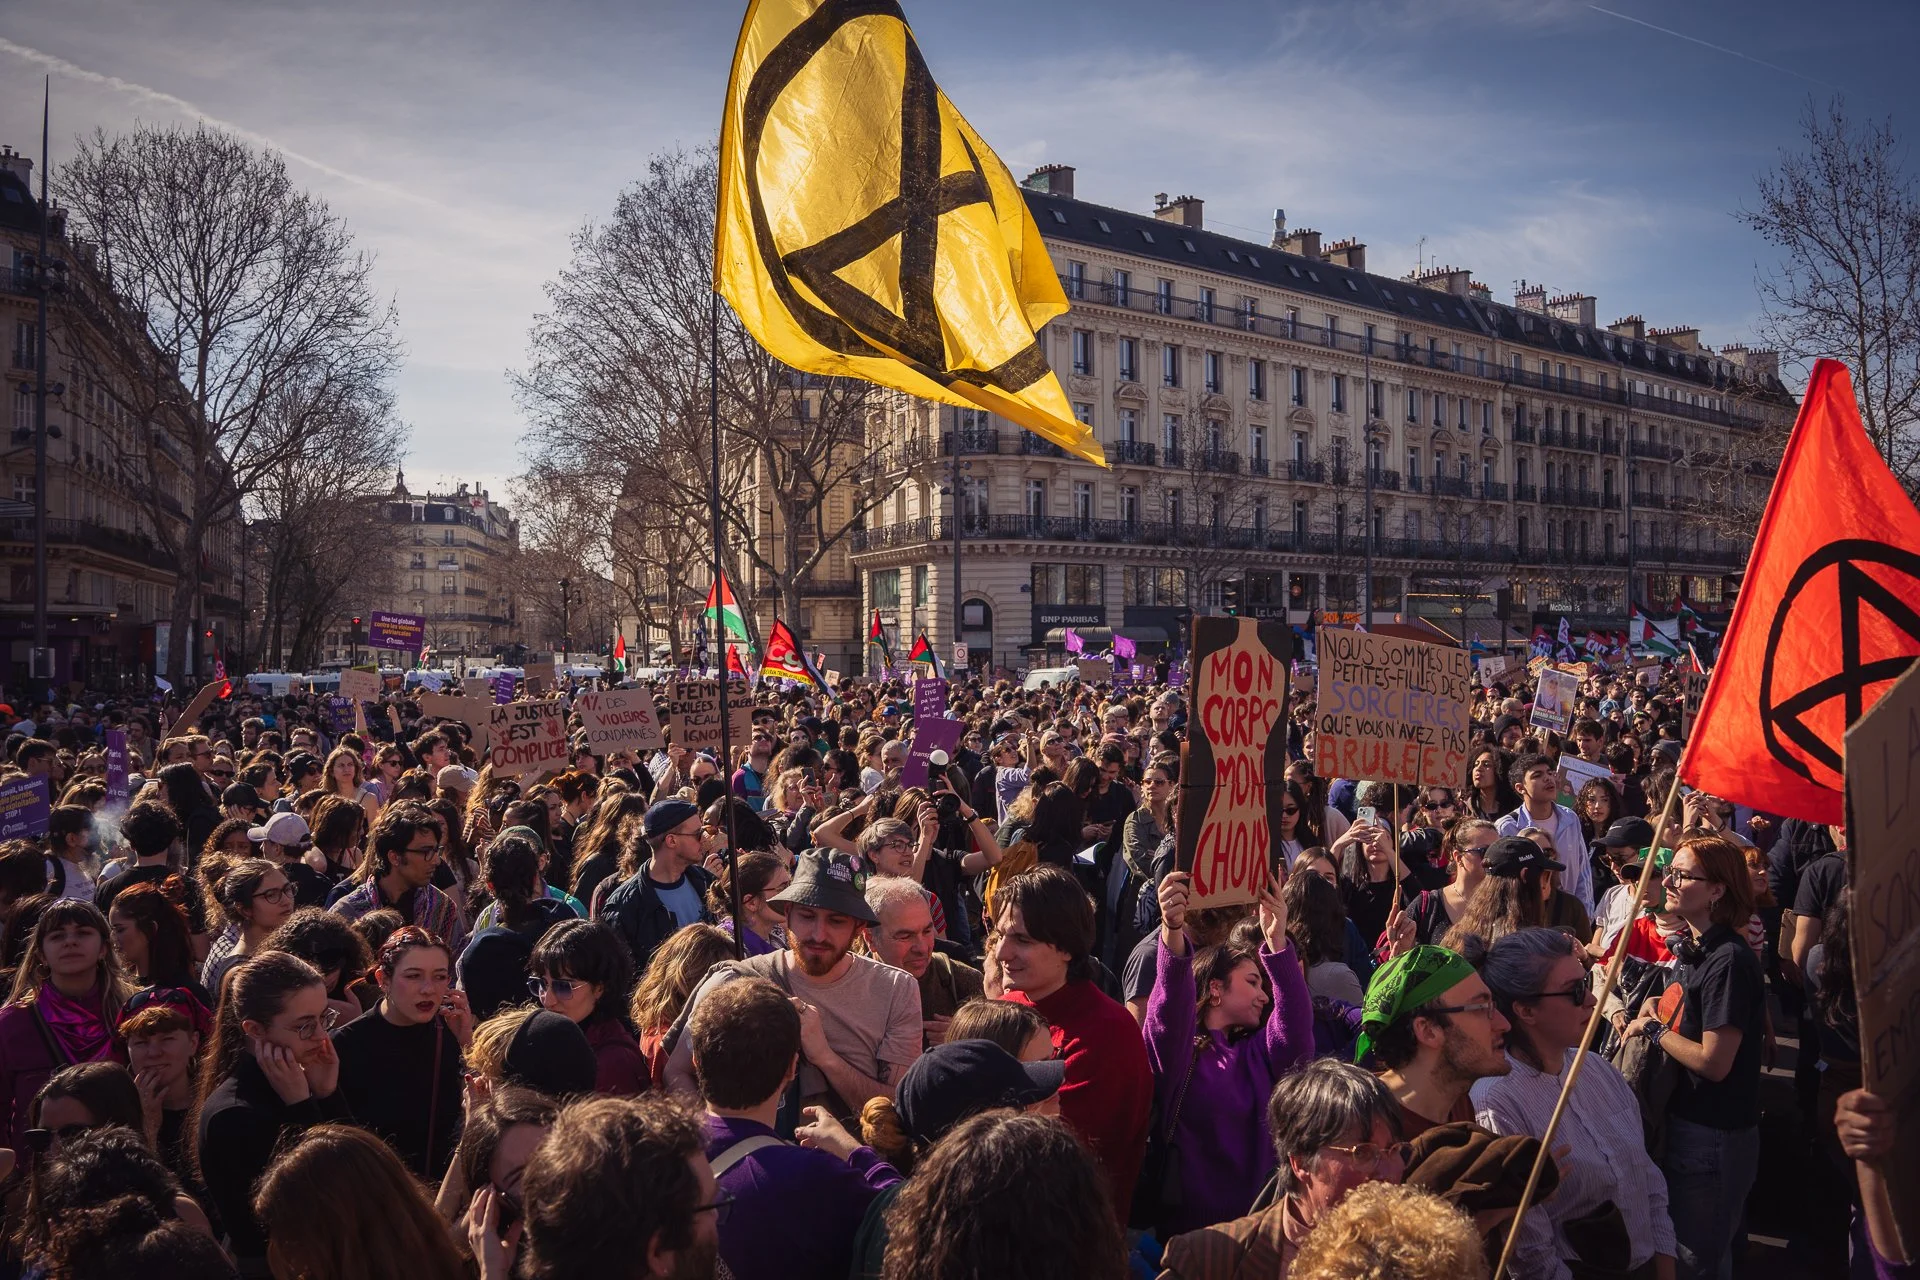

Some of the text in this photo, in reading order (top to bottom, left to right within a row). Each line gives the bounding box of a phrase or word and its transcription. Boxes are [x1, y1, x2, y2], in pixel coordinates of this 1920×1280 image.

[1210, 646, 1274, 696] MON
[1324, 632, 1470, 682] NOUS SOMMES LES
[1441, 676, 1466, 704] DES
[1688, 676, 1708, 693] MO
[491, 702, 561, 724] LA JUSTICE
[582, 694, 627, 711] 1% DES
[1331, 680, 1462, 731] SORCIÈRES
[510, 722, 542, 741] EST
[596, 710, 649, 726] VIOLEURS
[1202, 694, 1278, 751] CORPS
[592, 726, 657, 743] CONDAMNÉS
[1321, 714, 1352, 737] QUE
[1356, 718, 1384, 738] VOUS
[1441, 727, 1466, 754] PAS
[492, 738, 567, 768] COMPLICE
[1208, 751, 1265, 818] MON
[5, 810, 18, 819] STOP
[1194, 814, 1270, 898] CHOIX
